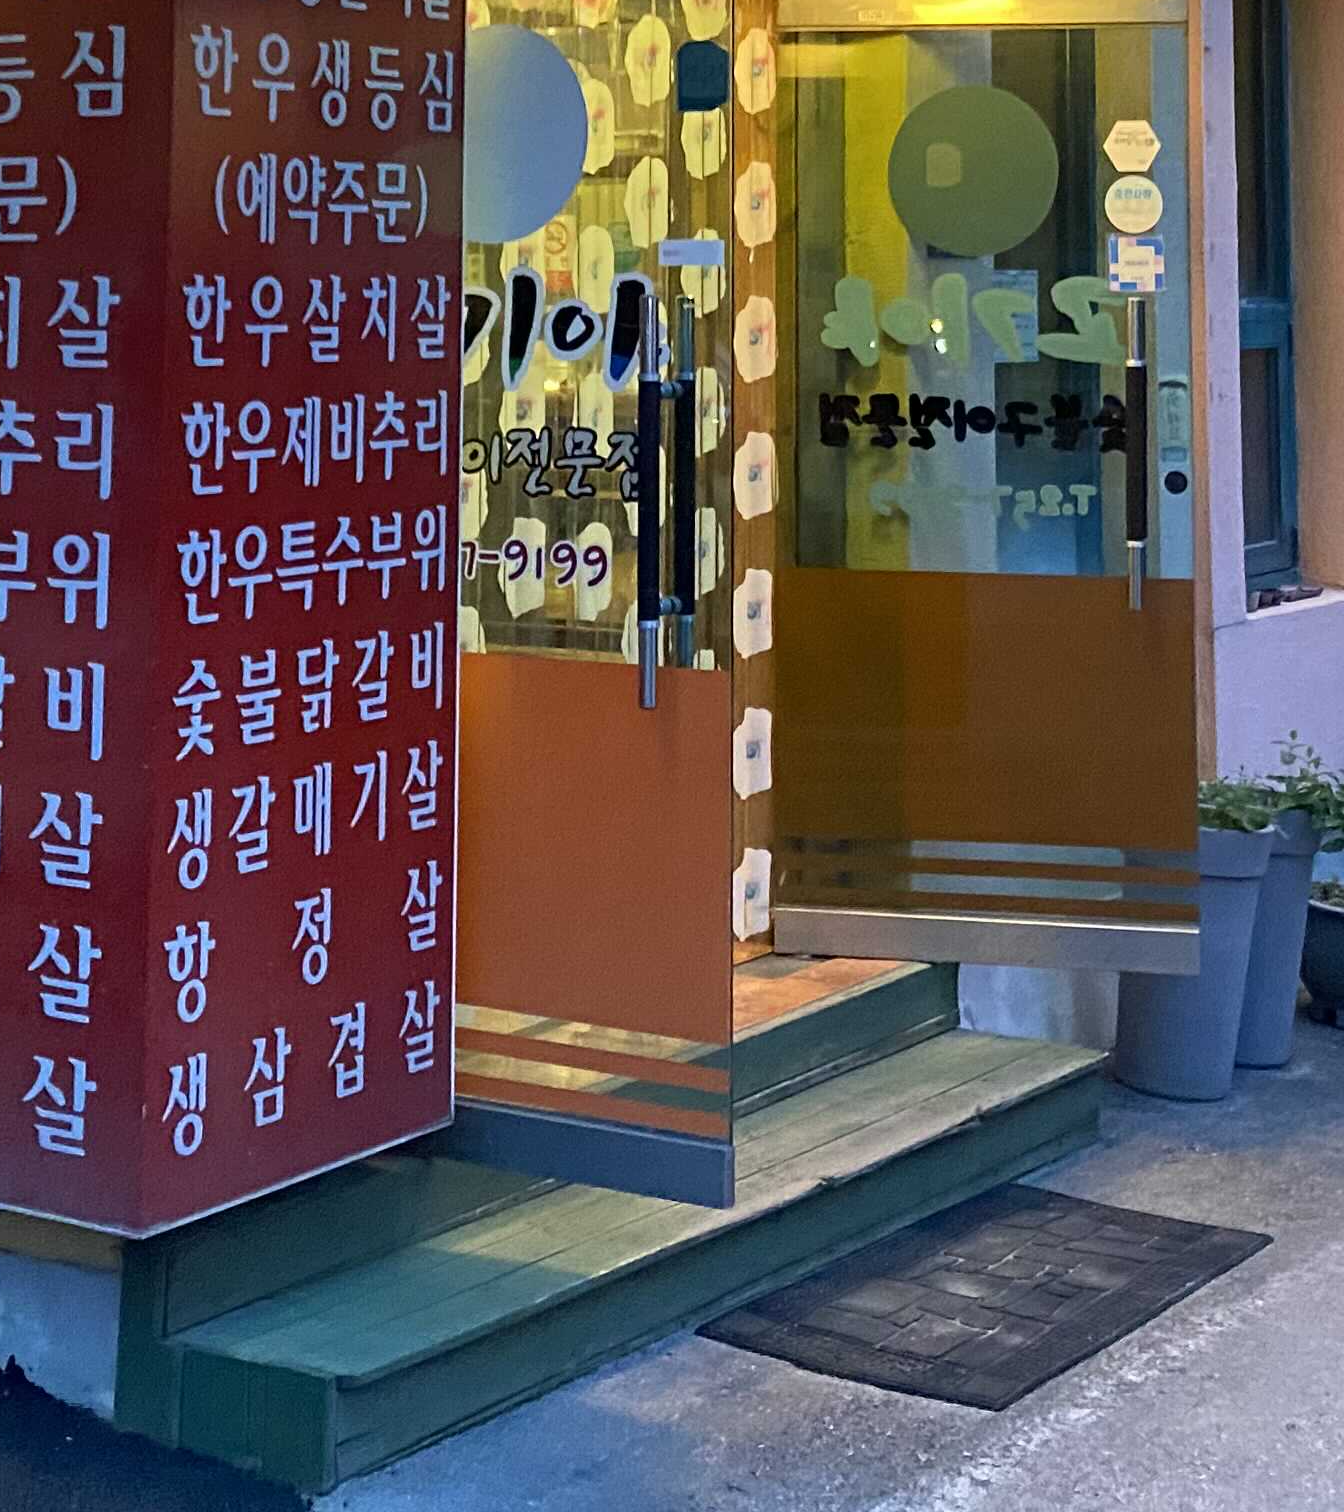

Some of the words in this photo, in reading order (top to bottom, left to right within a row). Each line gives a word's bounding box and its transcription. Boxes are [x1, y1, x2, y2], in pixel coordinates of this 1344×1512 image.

[191, 24, 455, 134] 한우생등심
[215, 152, 429, 246] (예약주문)
[183, 274, 451, 369] 한우살치살
[182, 391, 449, 498] 한우제비추리
[178, 504, 447, 626] 한우특수부위
